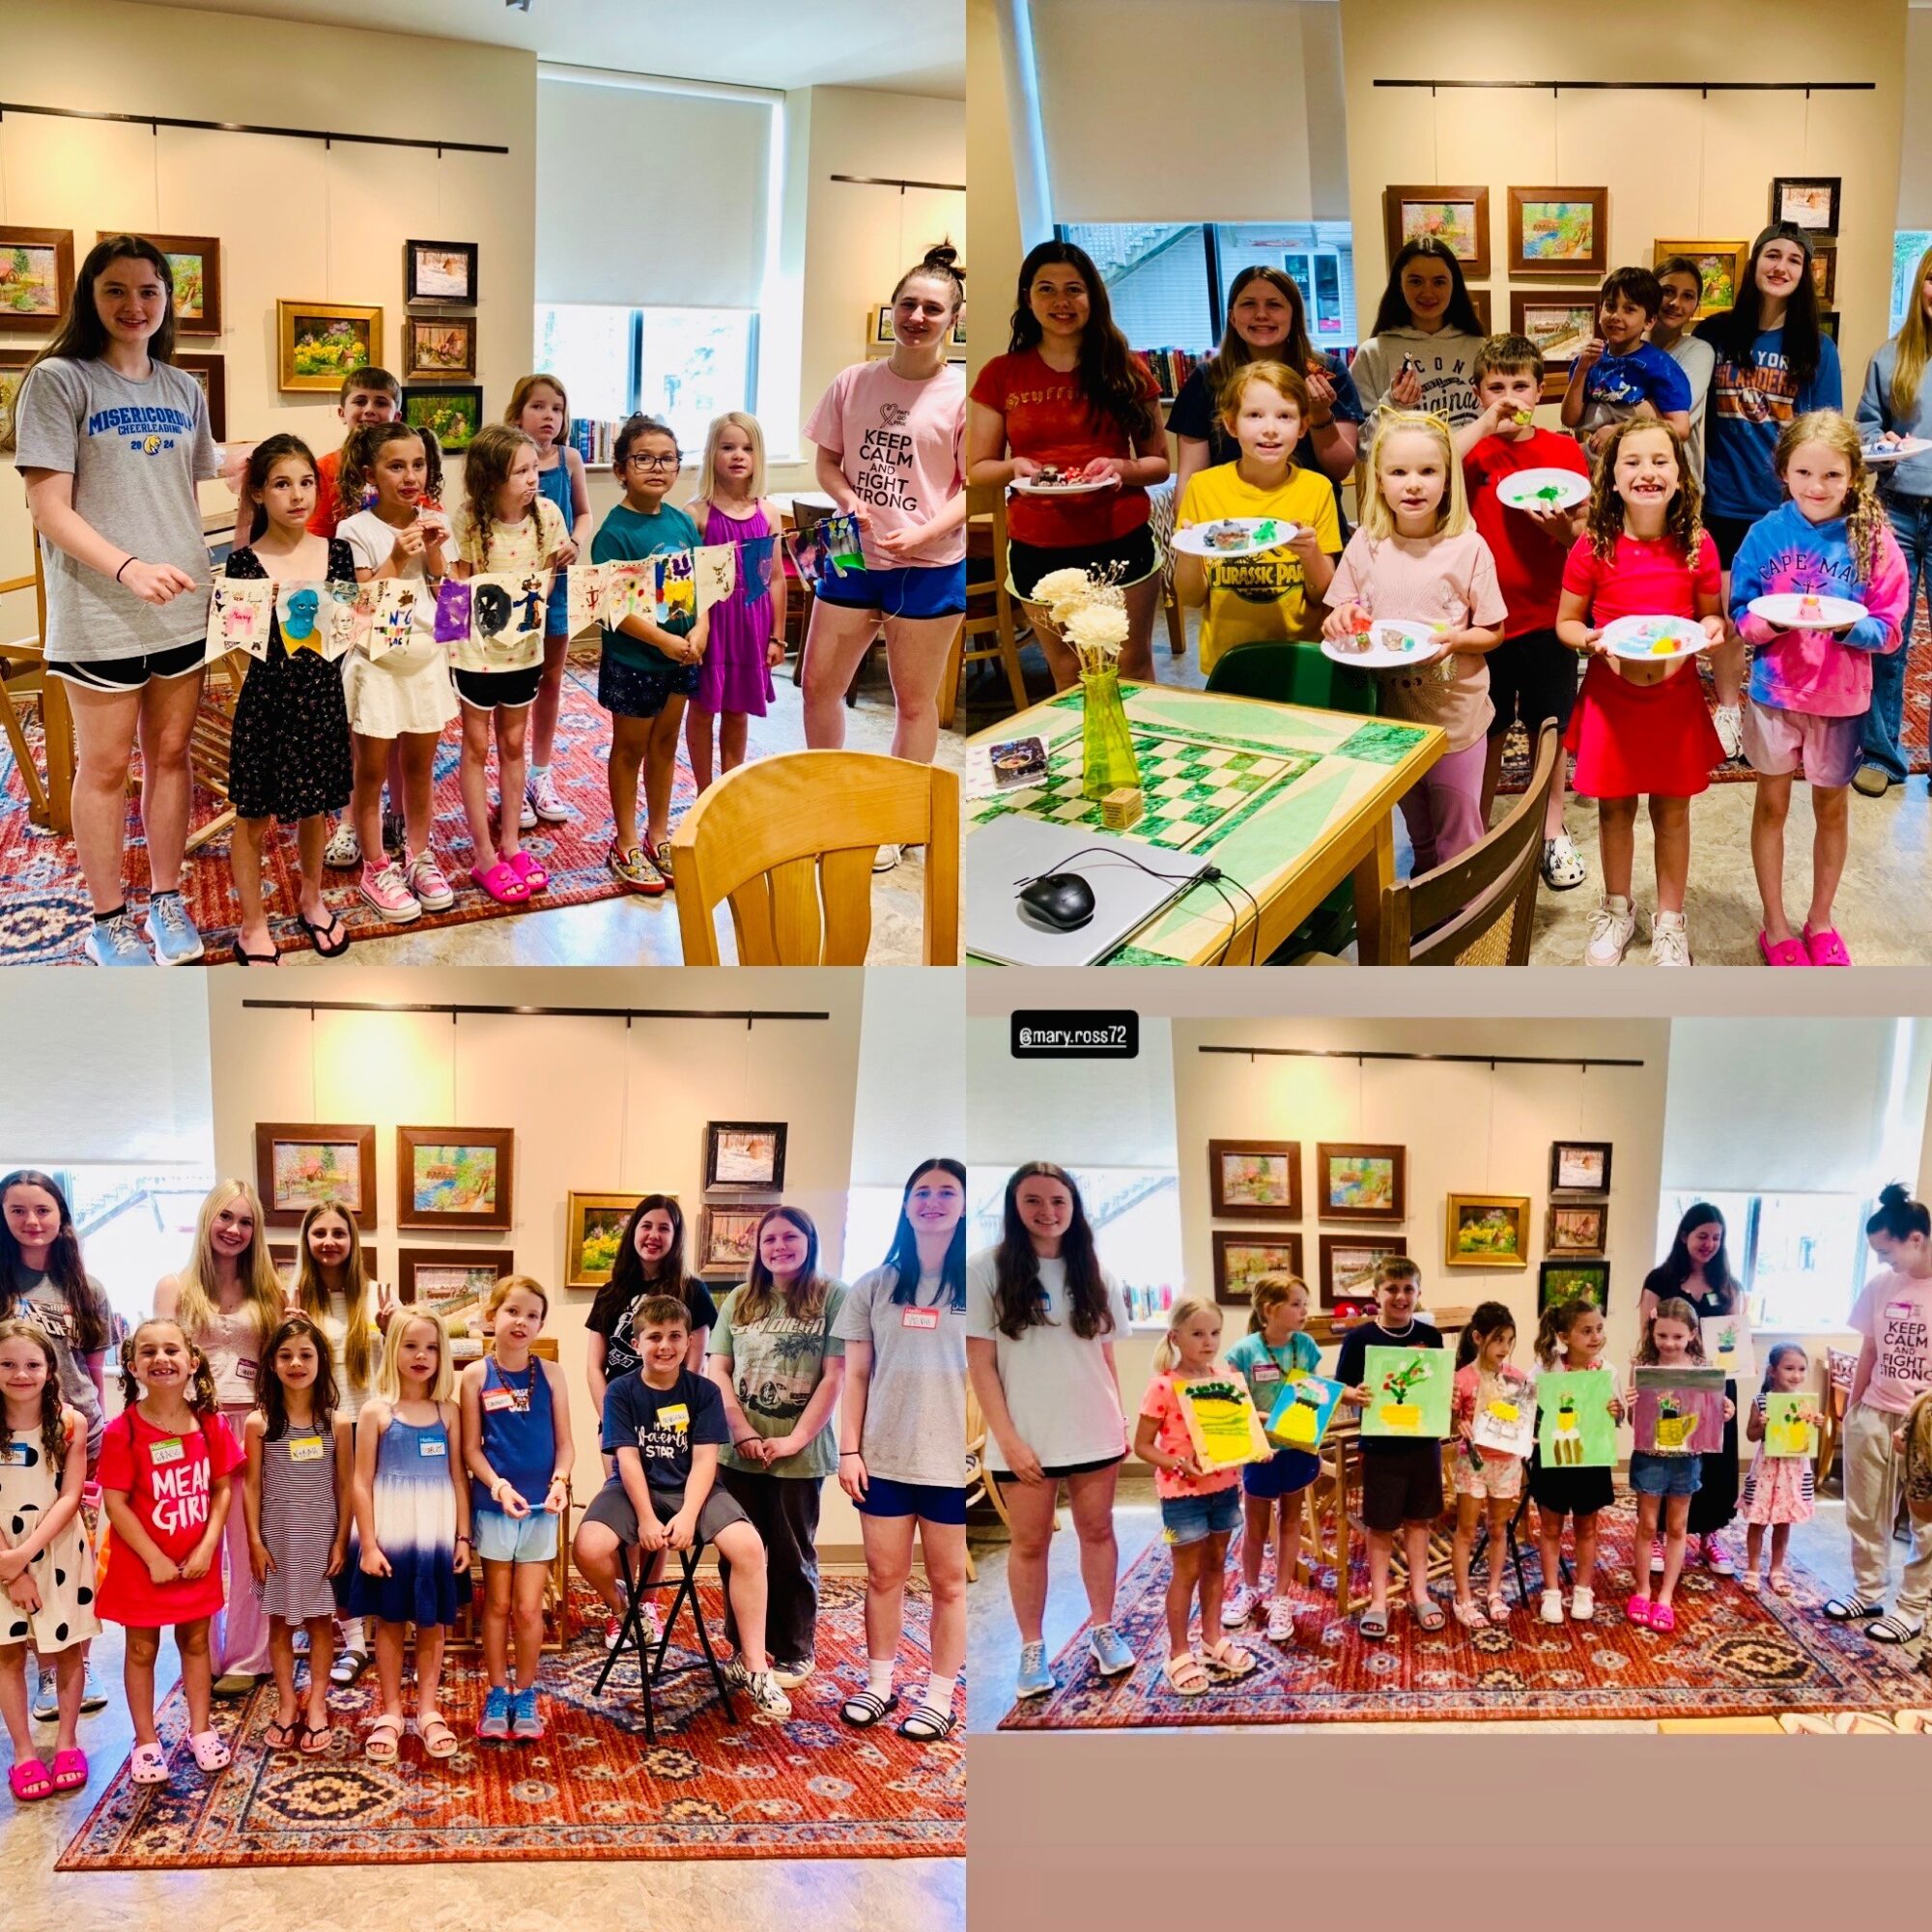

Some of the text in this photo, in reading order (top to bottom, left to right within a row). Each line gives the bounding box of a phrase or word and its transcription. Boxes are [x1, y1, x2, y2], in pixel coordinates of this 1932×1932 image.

[88, 407, 192, 437] MISERICORDIA
[865, 429, 912, 450] KEEP
[859, 444, 913, 469] CALM
[869, 462, 895, 475] AND
[858, 471, 909, 495] FIGHT
[1212, 565, 1274, 586] JURASSIC
[1759, 554, 1807, 581] CAPE
[1889, 1321, 1927, 1335] KEEP
[1884, 1333, 1928, 1349] CALM
[1893, 1347, 1916, 1355] AND
[1883, 1353, 1926, 1369] FIGHT
[645, 1444, 675, 1460] STAR
